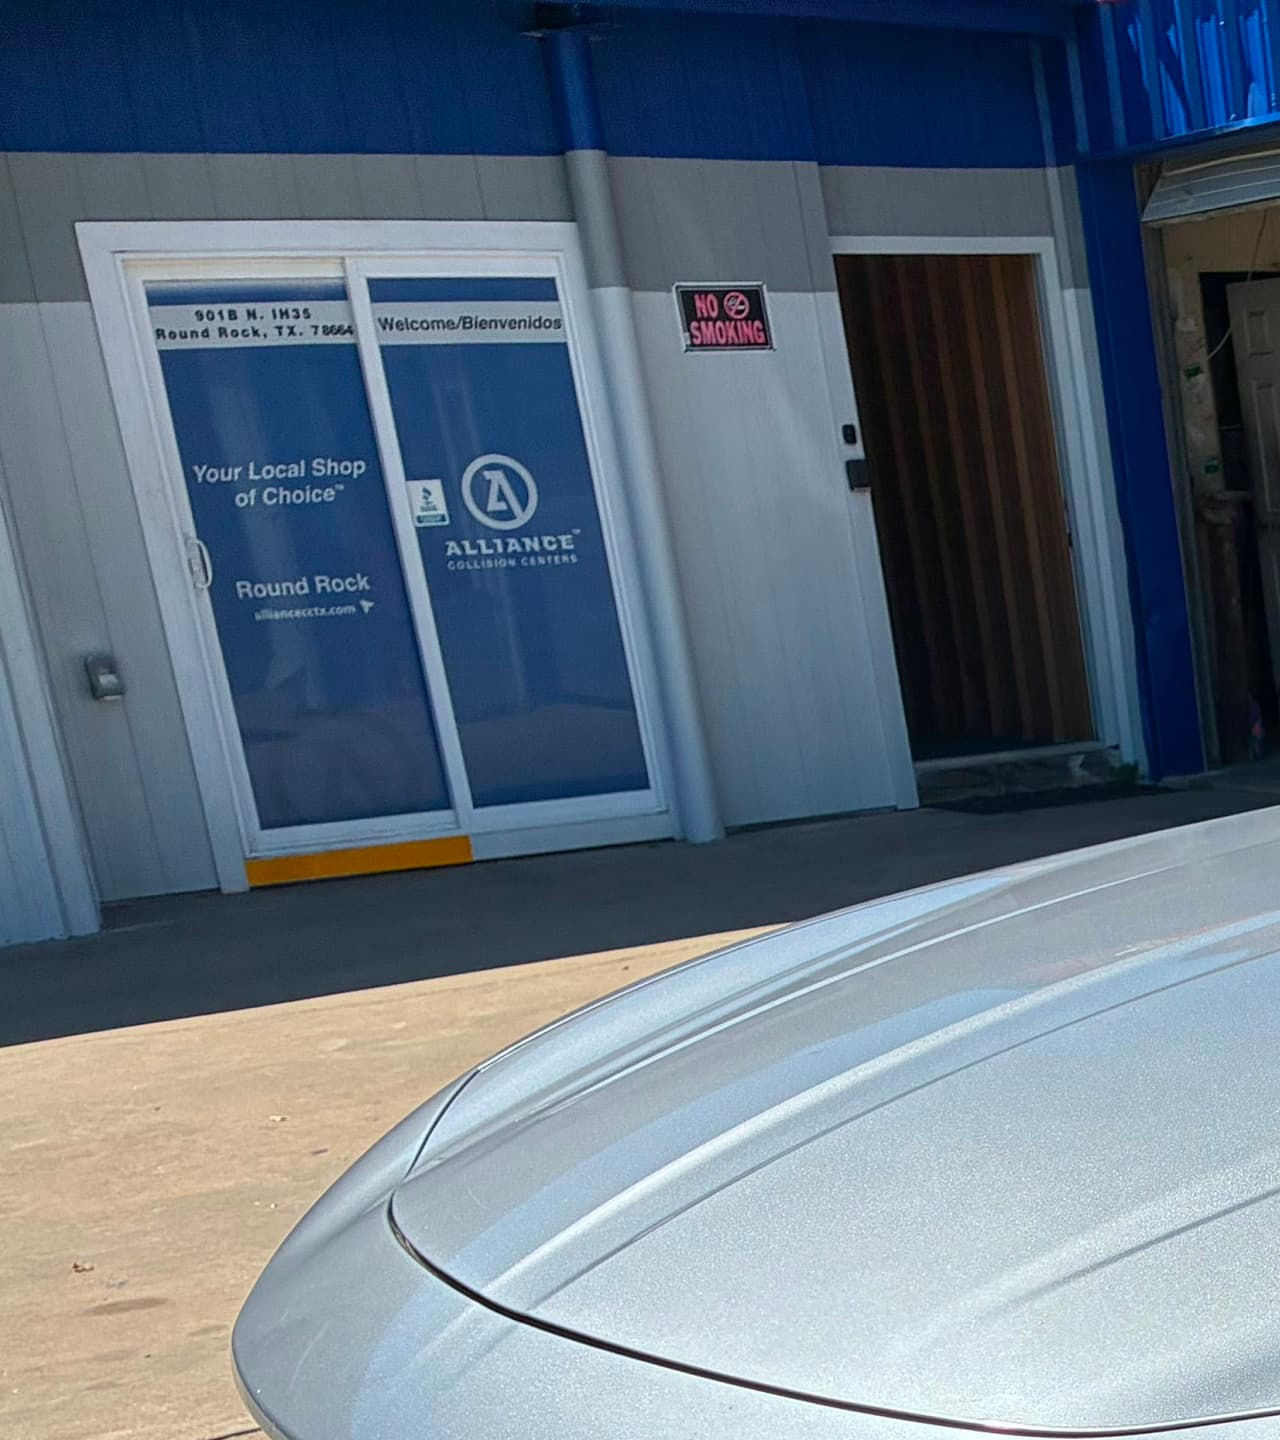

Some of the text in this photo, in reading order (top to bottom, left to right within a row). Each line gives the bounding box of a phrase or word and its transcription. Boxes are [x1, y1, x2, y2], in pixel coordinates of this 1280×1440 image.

[694, 293, 719, 318] NO
[156, 327, 210, 340] Round
[378, 315, 562, 331] Welcome/Bienvenidos
[690, 320, 766, 345] SMOKING
[193, 457, 366, 483] Your Local Shop
[235, 488, 258, 507] of
[447, 553, 579, 571] COLLISION CENTERS
[235, 572, 371, 600] Round Rock
